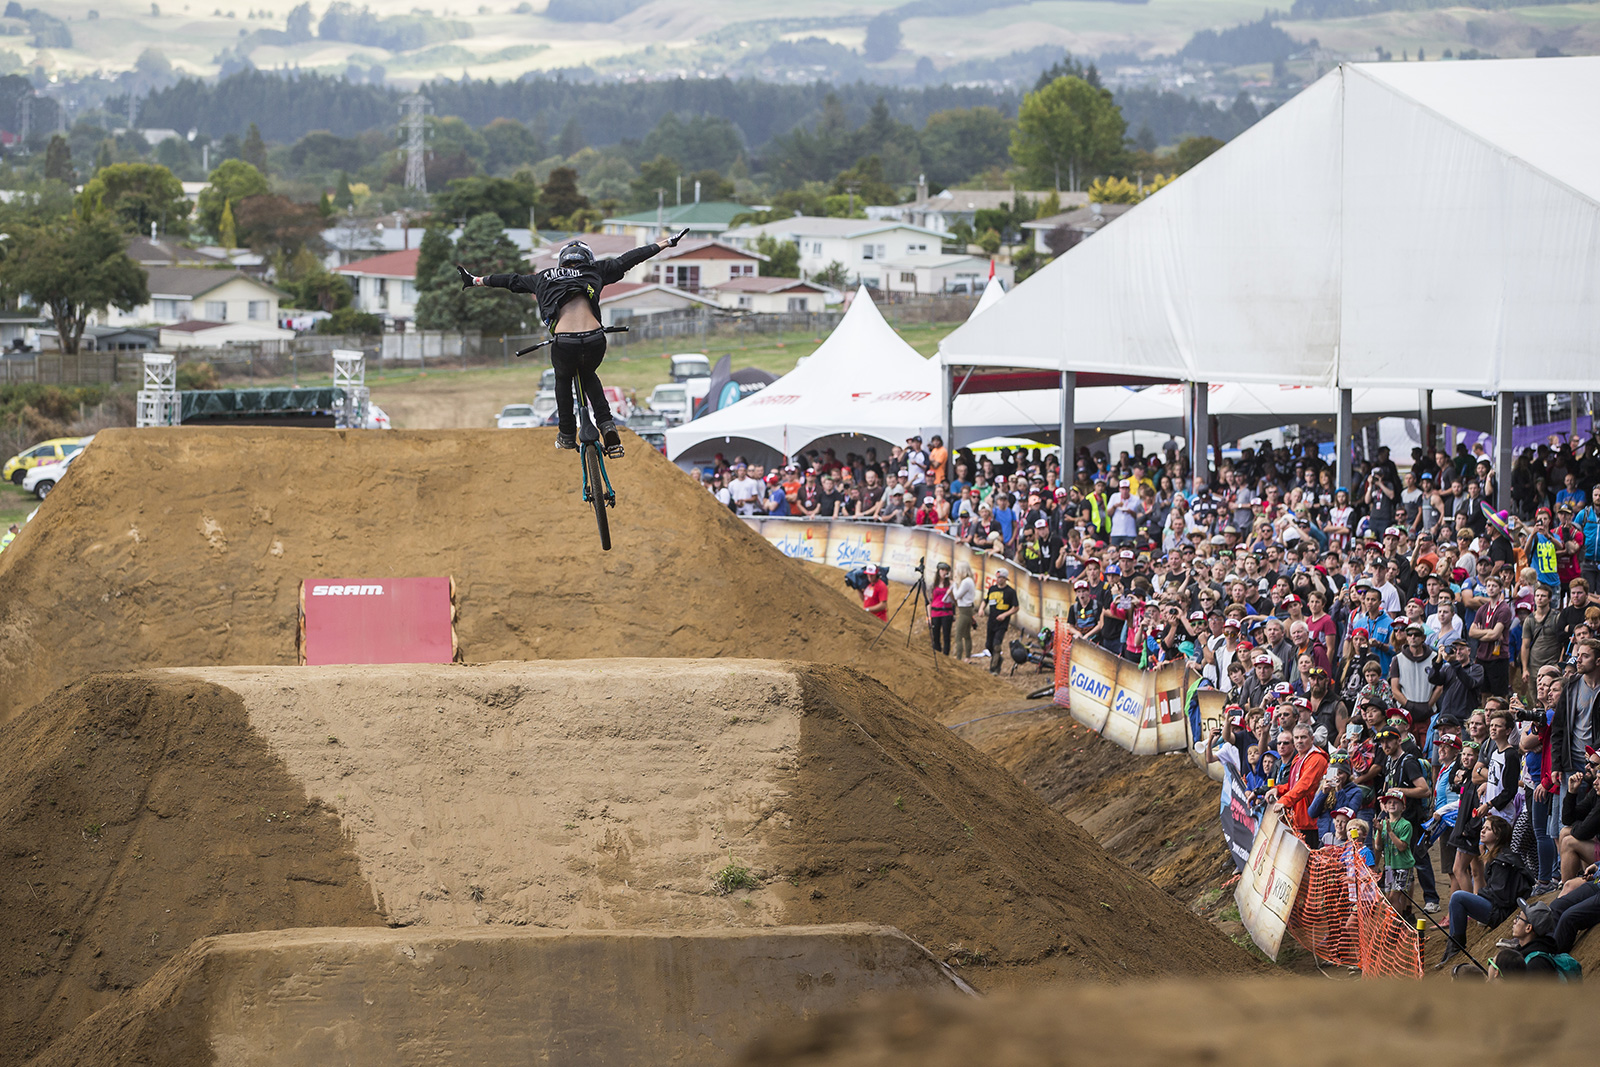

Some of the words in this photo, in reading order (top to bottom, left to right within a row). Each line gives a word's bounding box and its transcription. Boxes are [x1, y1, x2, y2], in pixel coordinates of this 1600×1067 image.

[836, 536, 871, 566] Skyline
[312, 585, 384, 596] SRAM
[1076, 673, 1112, 700] GIANT
[1122, 697, 1143, 719] GIAN
